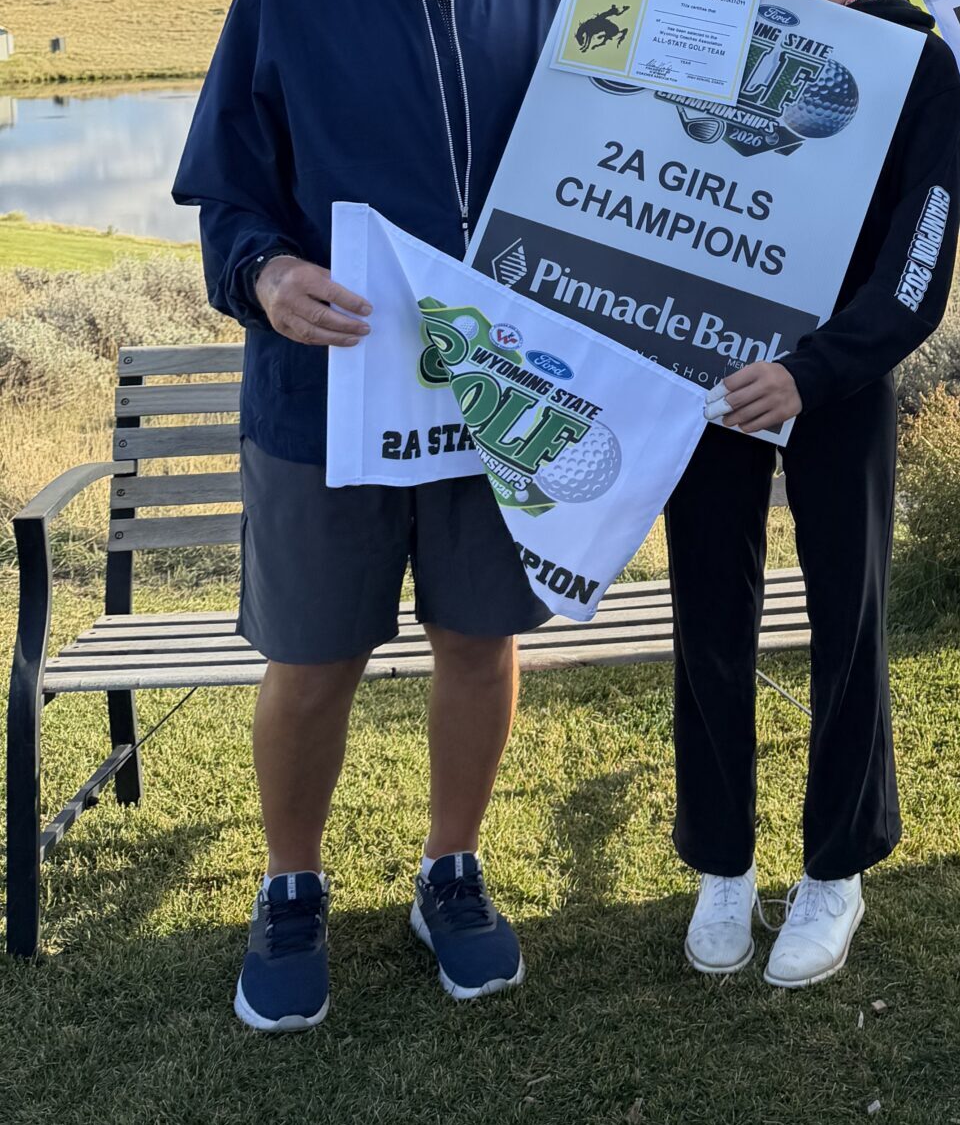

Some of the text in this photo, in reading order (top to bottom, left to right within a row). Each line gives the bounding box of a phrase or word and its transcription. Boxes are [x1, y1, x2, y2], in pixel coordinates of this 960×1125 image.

[764, 7, 792, 23] Ford
[652, 37, 726, 56] ALL-STATE GOLF TEAM
[784, 33, 834, 59] STATE
[729, 127, 763, 147] 2026
[597, 141, 774, 221] 2A GIRLS
[555, 177, 787, 276] CHAMPIONS
[897, 186, 950, 313] CHAMPION 2026
[529, 258, 692, 341] Pinnacle
[692, 312, 791, 363] Bank
[534, 354, 565, 376] Ford
[470, 347, 603, 421] WYOMING STATE
[382, 423, 477, 460] 2A STA
